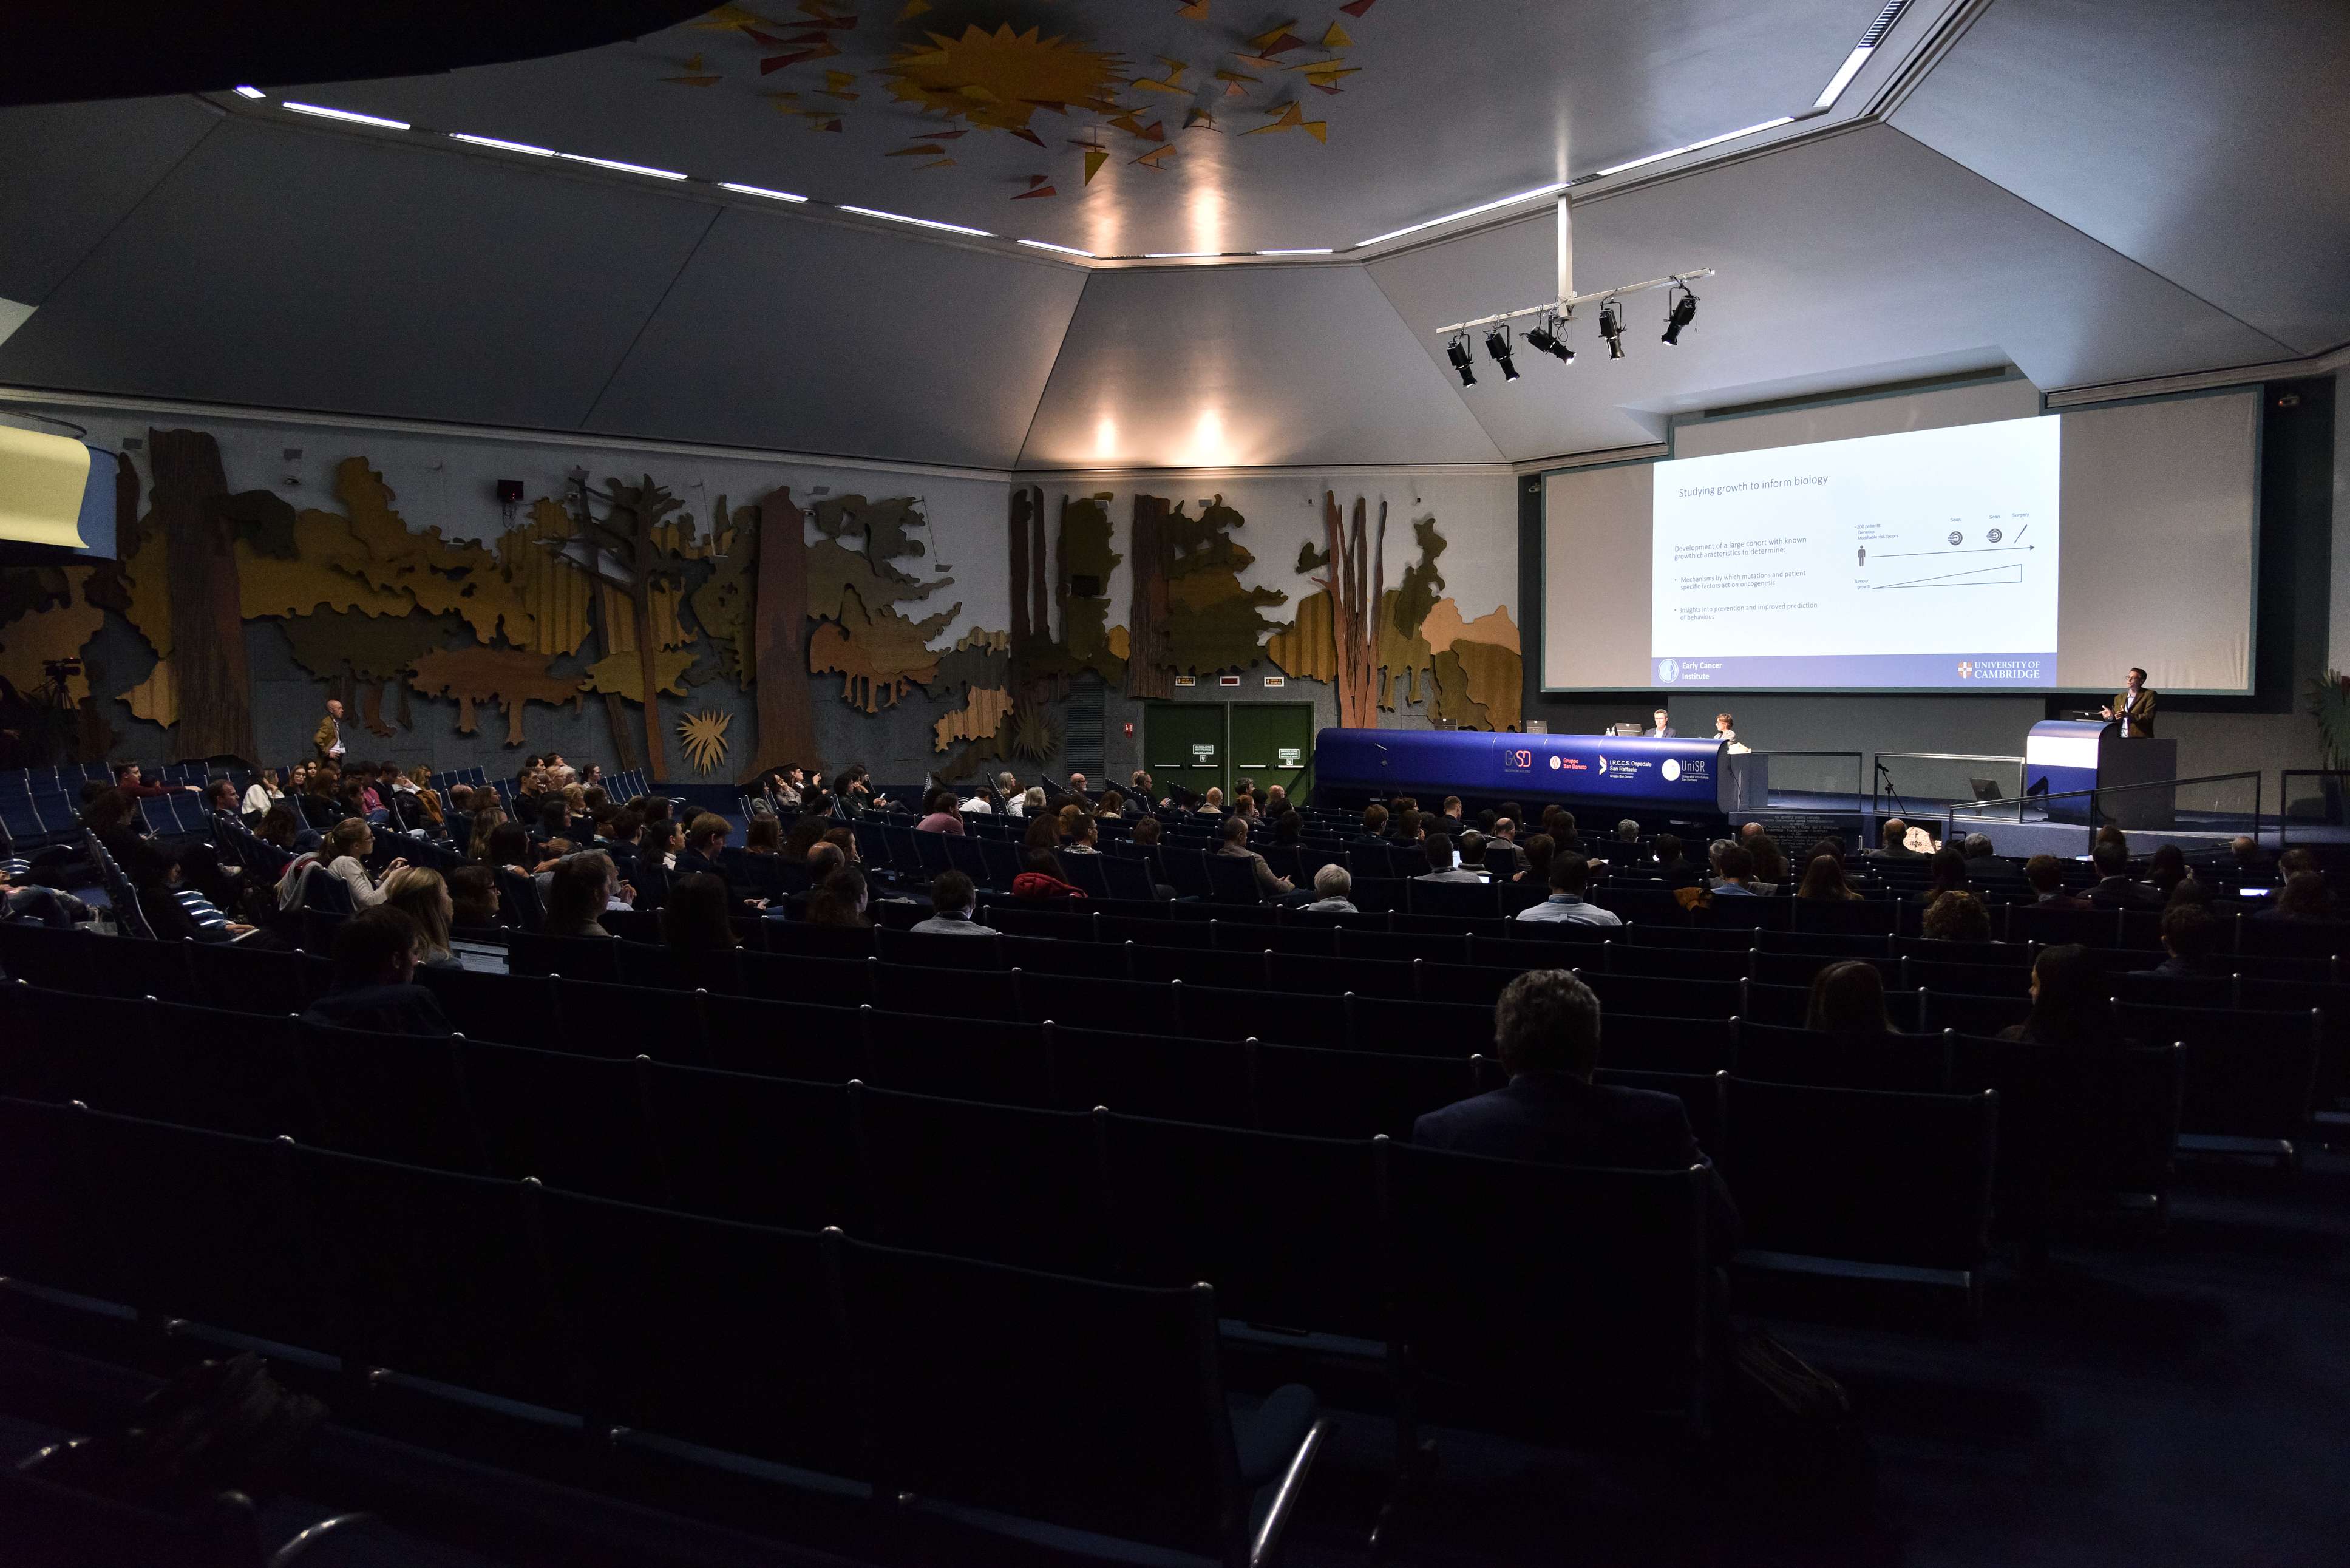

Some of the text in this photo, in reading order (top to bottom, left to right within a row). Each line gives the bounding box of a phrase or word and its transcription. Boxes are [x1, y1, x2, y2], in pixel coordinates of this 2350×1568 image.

[1679, 487, 1715, 498] Studying
[1717, 482, 1748, 495] growth
[1762, 478, 1791, 489] inform
[1795, 475, 1829, 486] biology
[1675, 544, 1714, 553] Development
[1729, 540, 1745, 550] large
[1674, 552, 1696, 562] growth
[1697, 550, 1740, 558] characteristics
[1750, 547, 1786, 555] determine:
[1784, 570, 1806, 579] patient
[1740, 580, 1776, 588] oncogenesis
[1758, 603, 1785, 611] improved
[1787, 602, 1818, 610] prediction
[1682, 662, 1698, 670] Early
[1974, 660, 2026, 669] UNIVERSITY
[1974, 670, 2040, 679] CAMBRIDGE
[1682, 760, 1705, 772] UniSR
